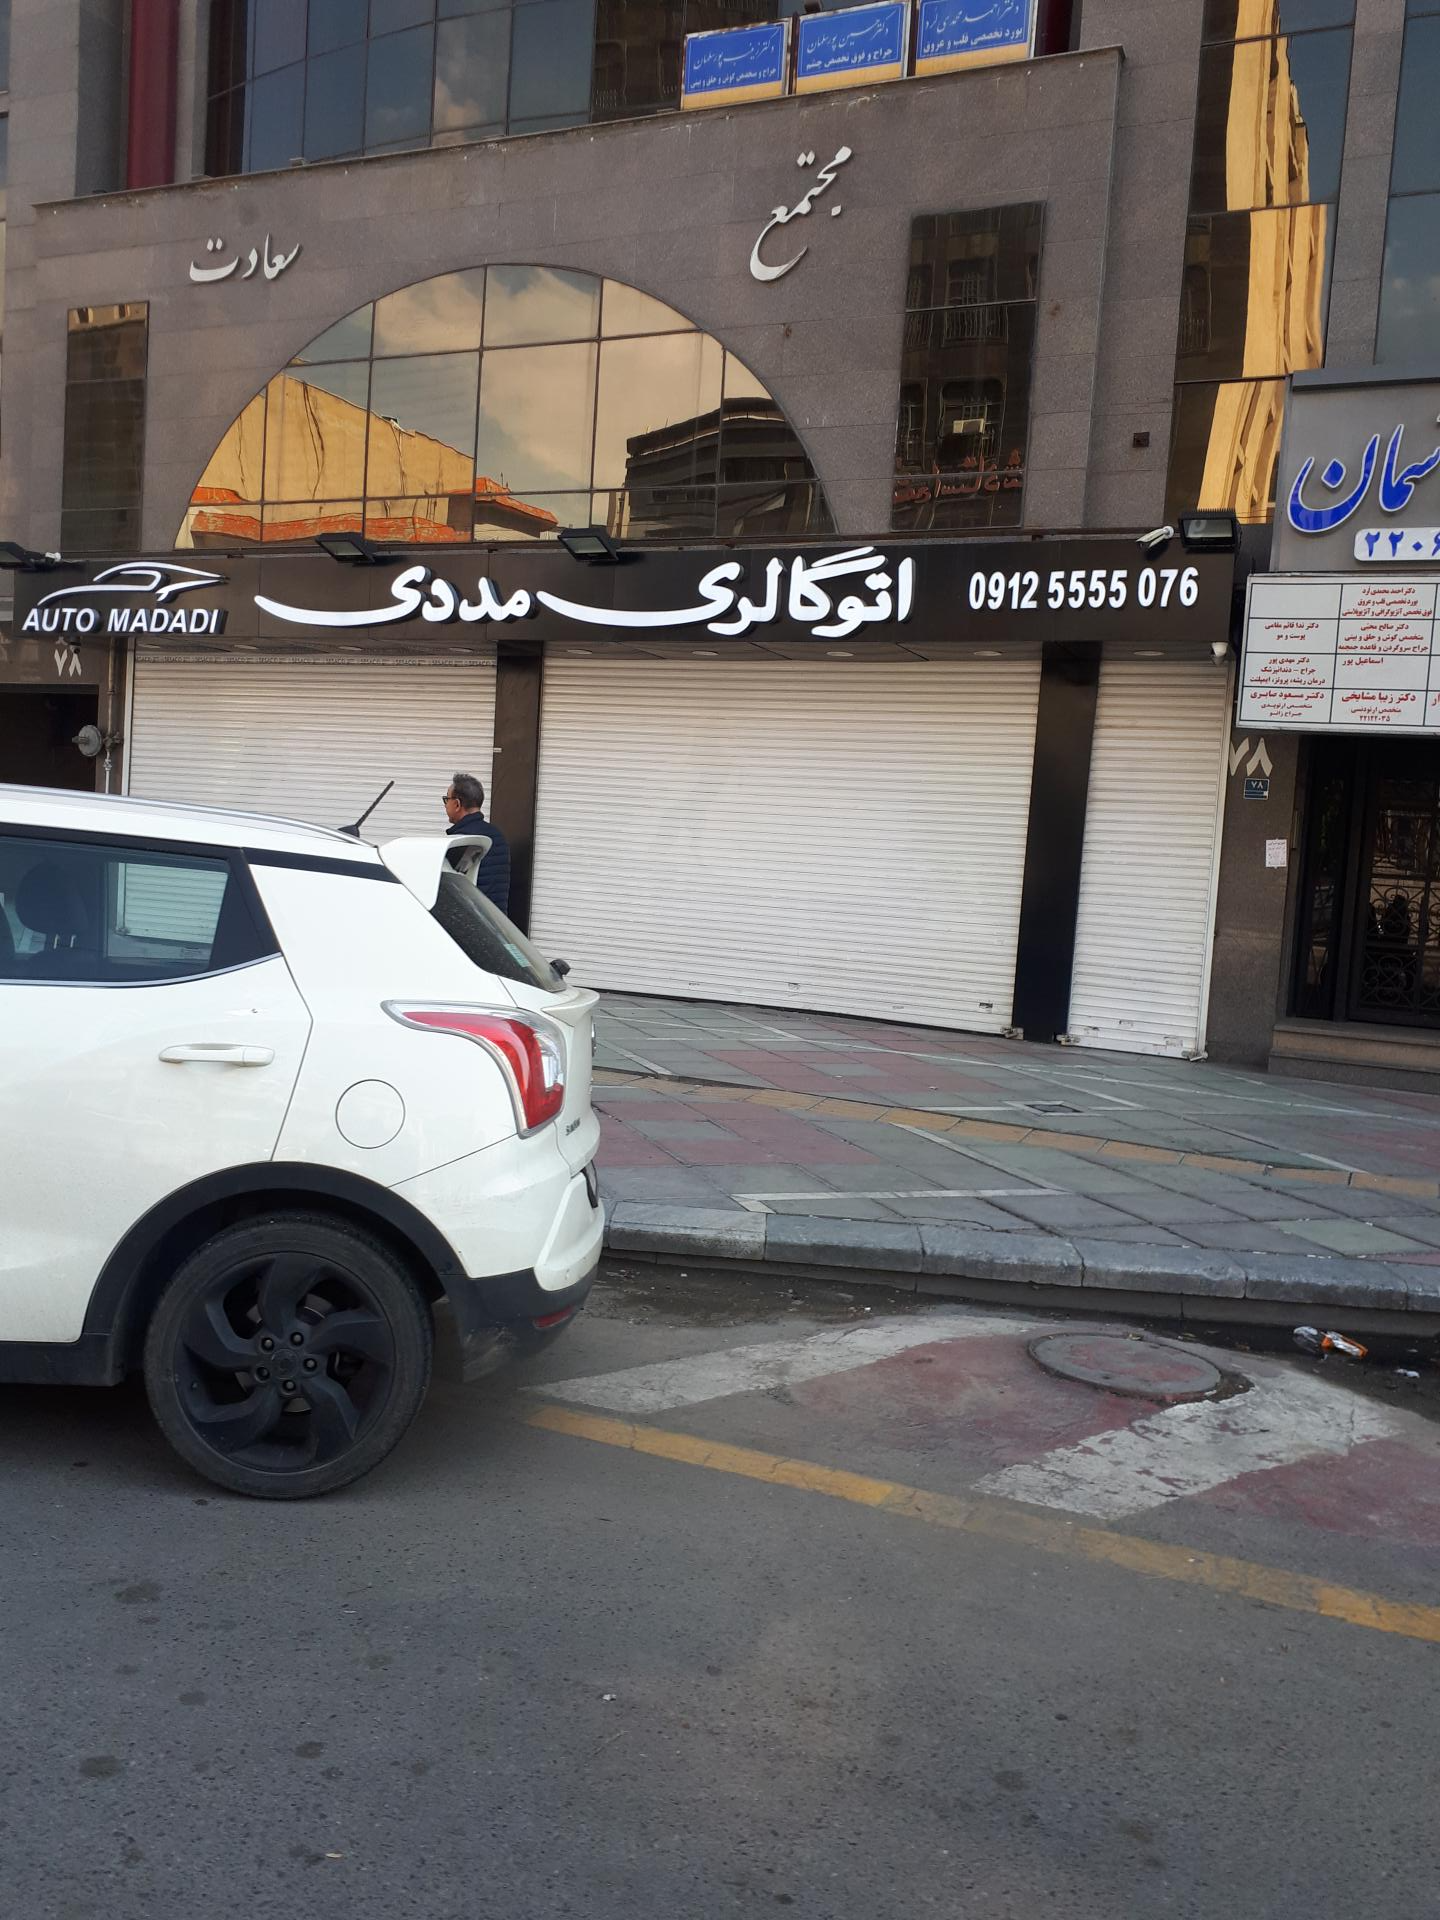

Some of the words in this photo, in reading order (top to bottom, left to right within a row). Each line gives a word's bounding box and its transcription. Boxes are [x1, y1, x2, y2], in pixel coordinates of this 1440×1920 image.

[953, 33, 969, 48] قلب
[923, 40, 944, 53] عروق
[850, 50, 866, 64] فوق
[873, 47, 893, 60] جراح
[806, 57, 822, 71] چشم
[762, 67, 776, 78] جراح
[749, 146, 851, 282] مجتمع
[189, 234, 300, 281] سعادت
[969, 570, 1038, 610] 0912
[1047, 569, 1127, 609] 5555
[1137, 566, 1199, 608] 076
[1371, 588, 1389, 596] محمدی
[1390, 587, 1404, 595] احمد
[1404, 587, 1416, 596] دکتر
[254, 564, 533, 627] مددی
[1386, 598, 1407, 607] تخصصی
[1422, 609, 1433, 617] فوق
[22, 607, 96, 633] AUTO
[107, 607, 220, 635] MADADI
[1306, 622, 1319, 631] دکتر
[1379, 623, 1394, 632] صالح
[1395, 623, 1409, 632] دکتر
[1289, 633, 1306, 641] پوست
[1344, 634, 1358, 642] بینی
[1363, 633, 1376, 642] حلق
[1382, 633, 1398, 642] گوش
[1398, 634, 1424, 642] متخصص
[1360, 643, 1377, 651] قاعده
[1412, 645, 1429, 653] جراح
[54, 649, 82, 677] ۷۸
[1296, 657, 1310, 665] دکتر
[1355, 657, 1384, 666] اسماعیل
[1300, 667, 1317, 675] جراح
[1307, 678, 1326, 686] درمان
[1279, 691, 1304, 700] مسعود
[1305, 691, 1325, 701] دکتر
[1341, 690, 1377, 702] مشایخی
[1378, 692, 1395, 703] زیبا
[1395, 692, 1417, 704] دکتر
[1229, 736, 1273, 777] ۷۸
[1251, 781, 1264, 789] ۷۸
